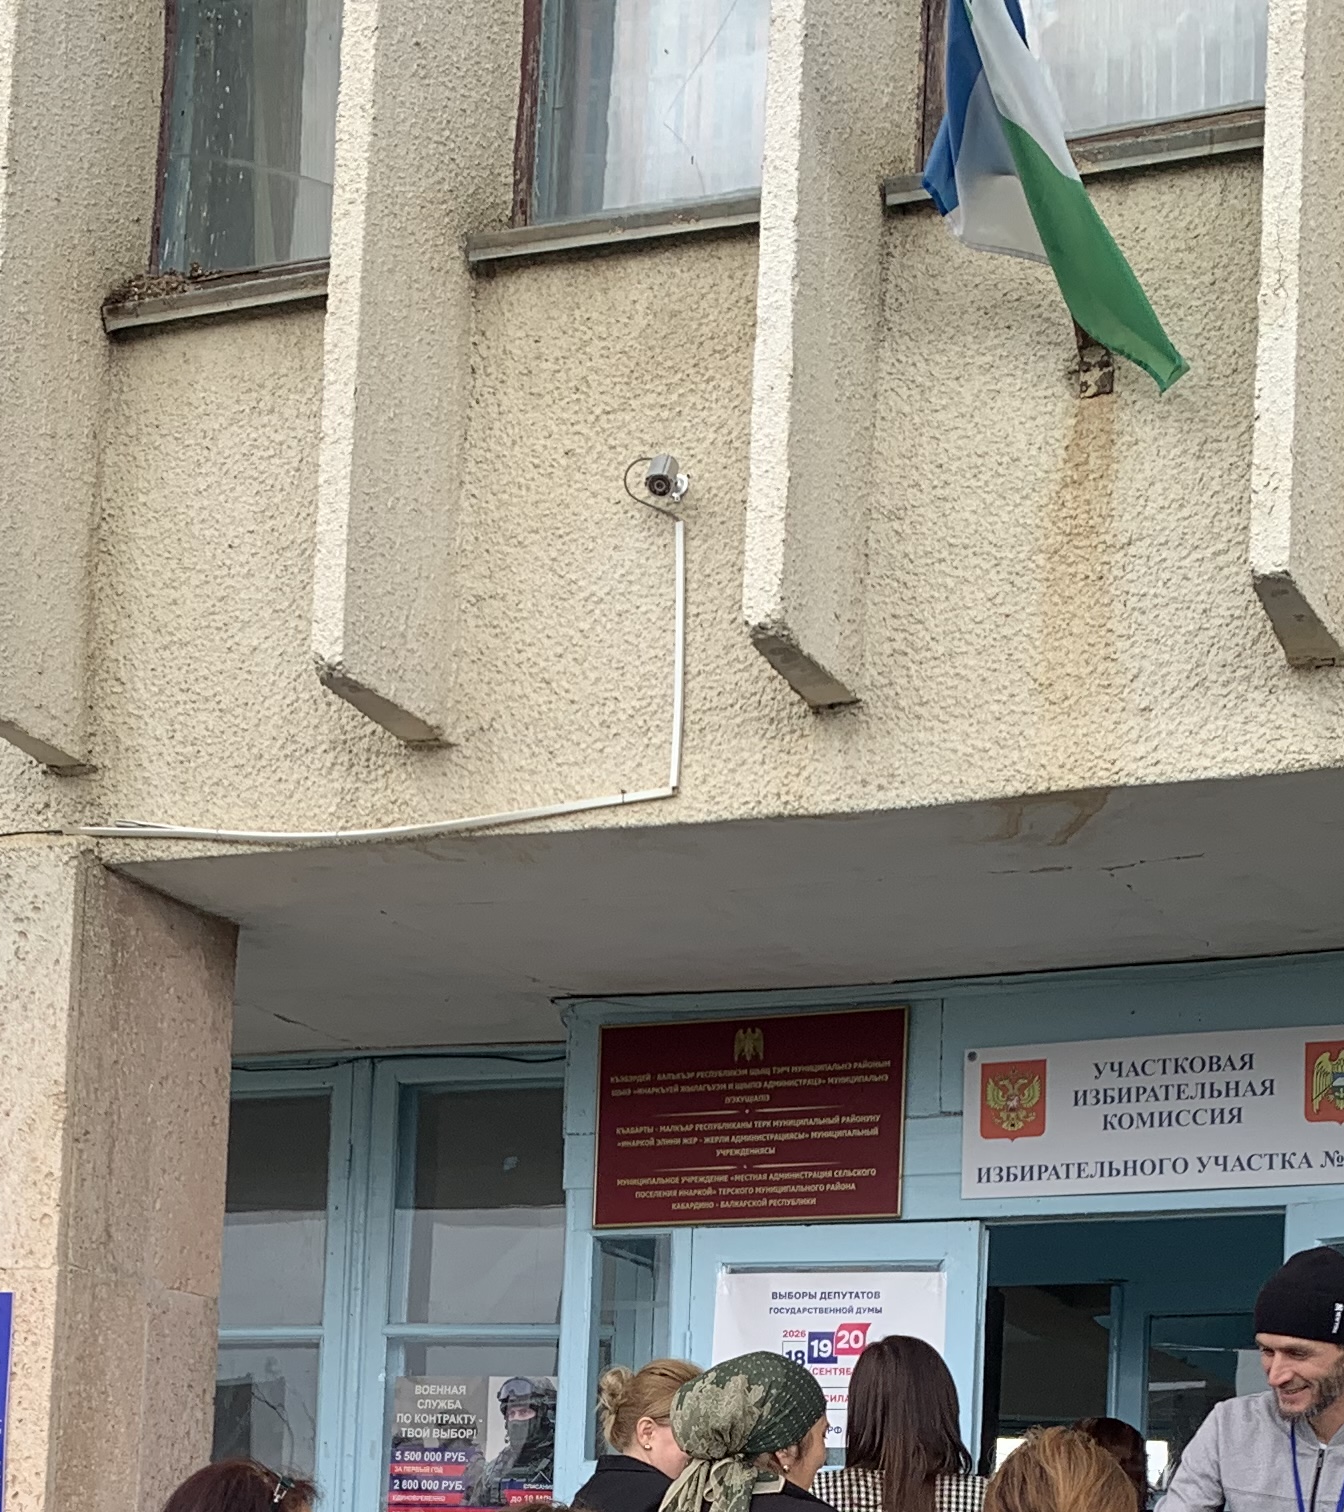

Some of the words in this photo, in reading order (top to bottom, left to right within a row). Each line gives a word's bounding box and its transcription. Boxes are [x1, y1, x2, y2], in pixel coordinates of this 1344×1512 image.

[1093, 1052, 1255, 1080] УЧАСТКОВАЯ
[1073, 1077, 1276, 1107] ИЗБИРАТЕЛЬНАЯ
[1101, 1106, 1243, 1132] КОМИССИЯ
[833, 1168, 877, 1177] СЕЛЬСКОГО
[976, 1156, 1189, 1185] ИЗБИРАТЕЛЬНОГО
[1196, 1150, 1313, 1174] УЧАСТКА
[718, 1186, 754, 1196] ТЕРСКОГО
[826, 1181, 856, 1190] РАЙОНА
[771, 1291, 817, 1300] ВЫБОРЫ
[819, 1291, 881, 1301] ДЕПУТАТОВ
[769, 1305, 854, 1315] ГОСУДАРСТВЕННОЙ
[855, 1307, 883, 1315] ДУМЫ
[782, 1330, 806, 1338] 2026
[785, 1350, 805, 1366] 18
[810, 1339, 832, 1358] 19
[836, 1330, 864, 1349] 20
[812, 1367, 853, 1376] СЕНТЯБ
[415, 1384, 467, 1395] ВОЕННАЯ
[417, 1399, 462, 1410] СЛУЖБА
[396, 1413, 413, 1424] ПО
[414, 1413, 477, 1425] КОНТРАКТУ
[400, 1427, 431, 1438] ТВОЙ
[432, 1427, 478, 1440] ВЫБОР!
[395, 1451, 402, 1461] 5
[403, 1451, 422, 1461] 500
[424, 1451, 442, 1462] 000
[444, 1452, 469, 1462] РУБ.
[393, 1479, 400, 1490] 2
[421, 1480, 439, 1490] 000
[441, 1480, 465, 1491] РУБ.
